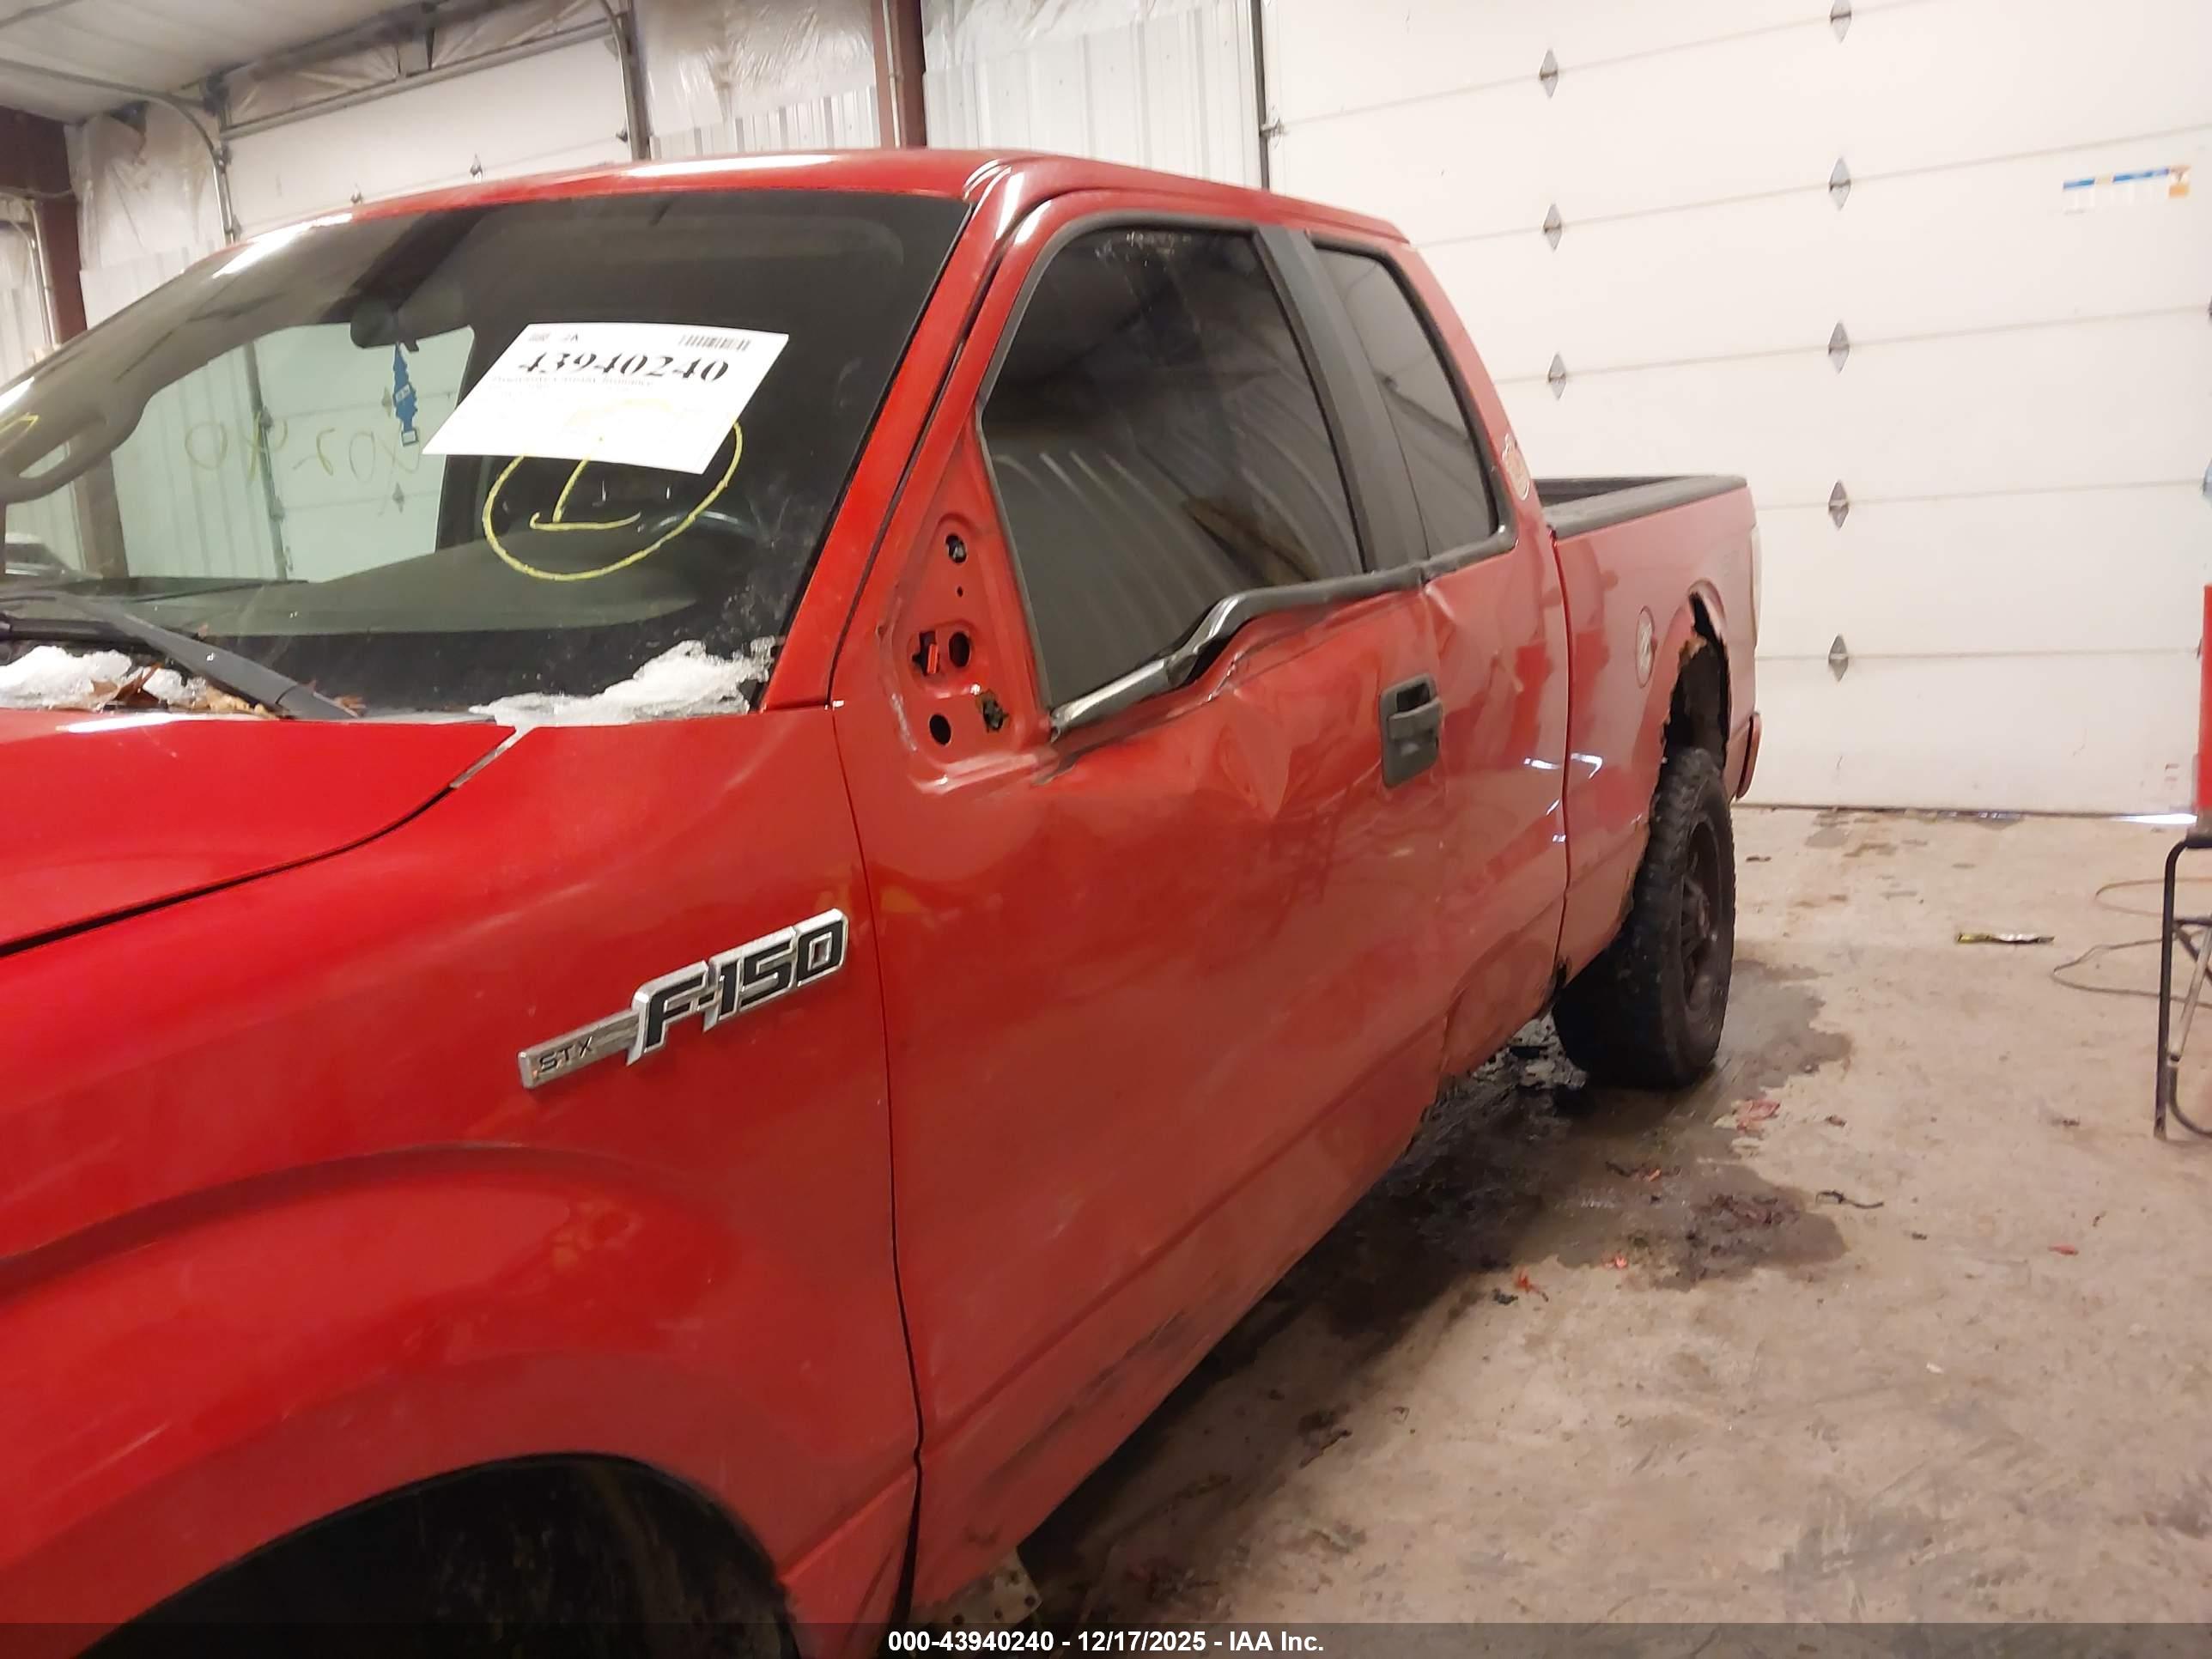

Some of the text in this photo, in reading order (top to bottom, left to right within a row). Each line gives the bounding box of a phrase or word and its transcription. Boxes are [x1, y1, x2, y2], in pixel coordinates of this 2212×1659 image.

[519, 349, 730, 383] 43940240
[627, 908, 850, 1066] F-150
[538, 1036, 594, 1073] STX
